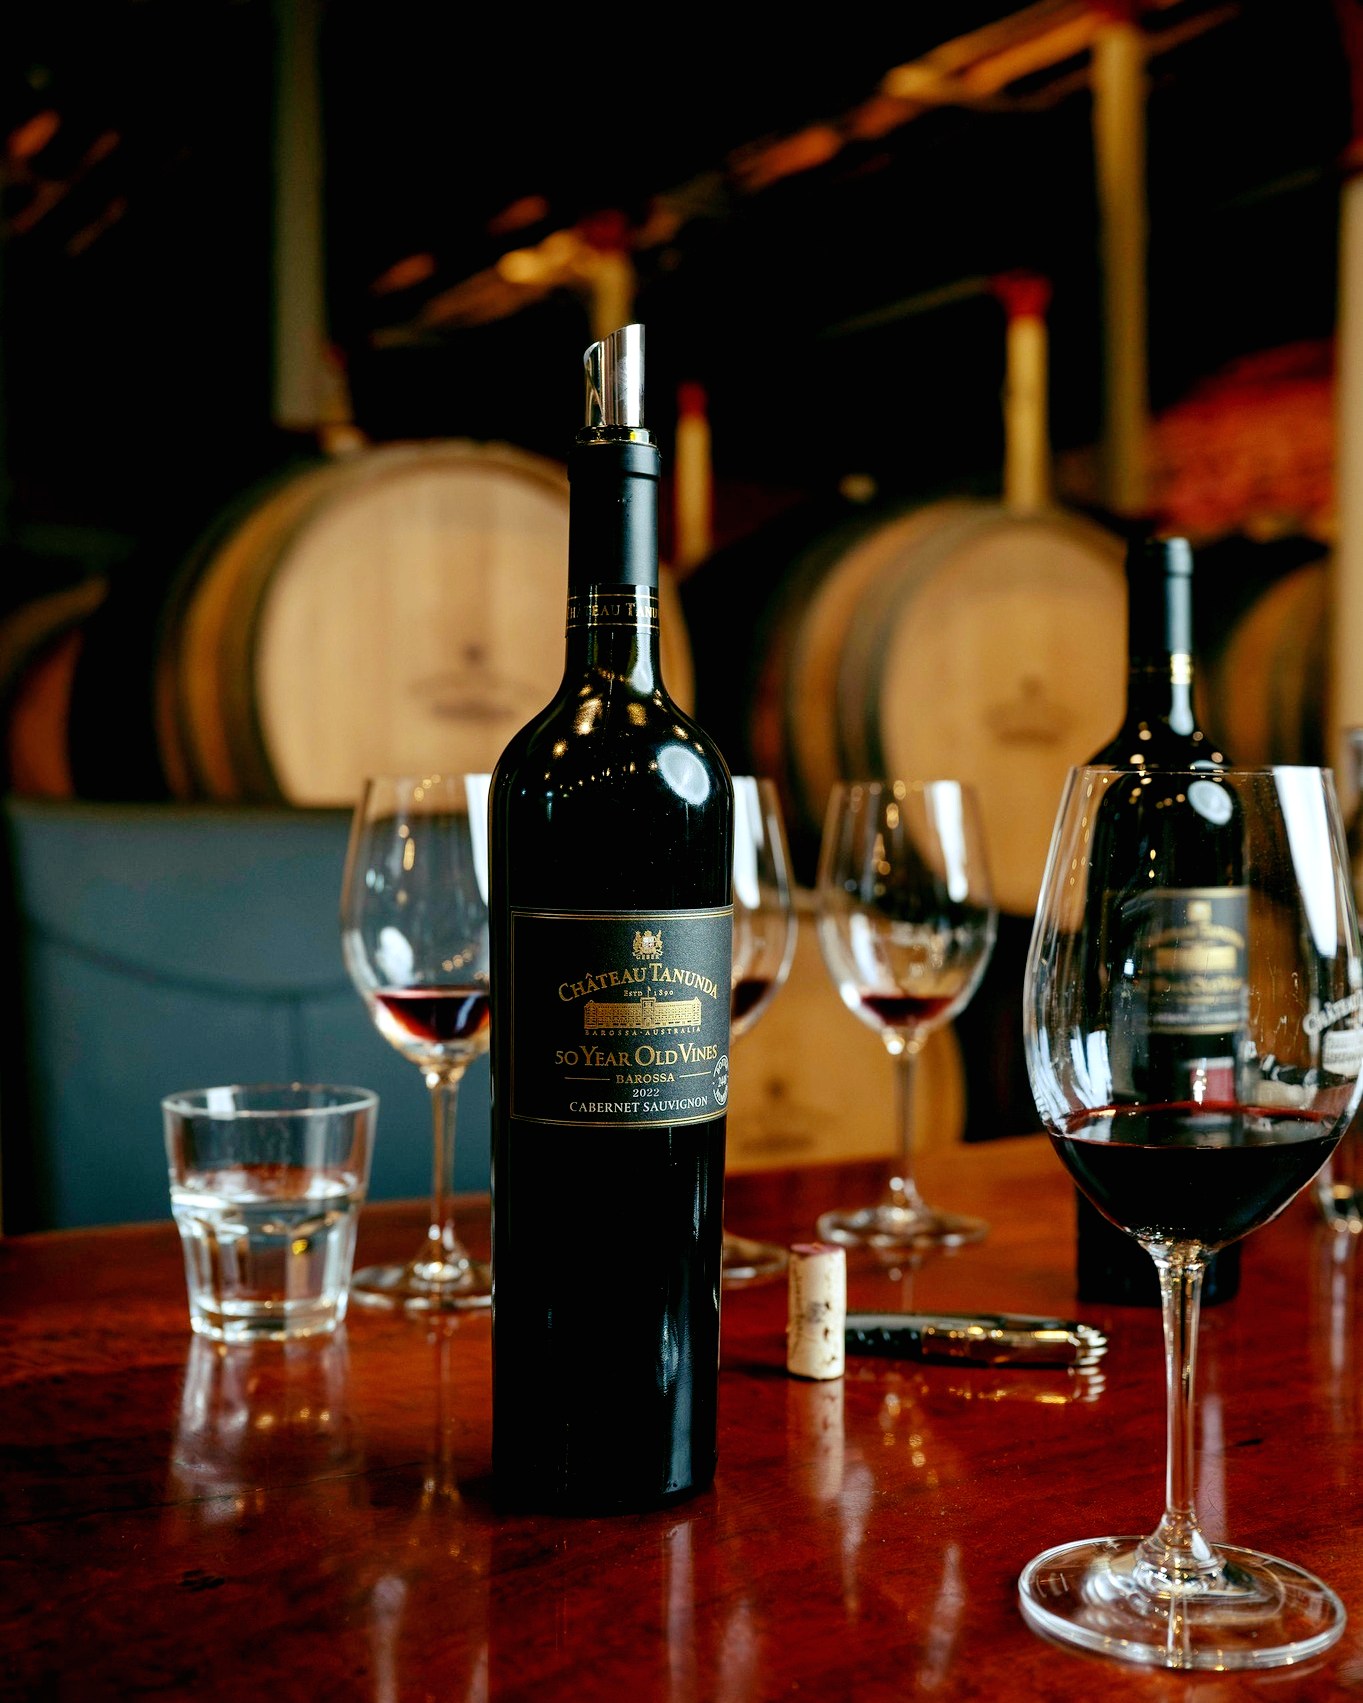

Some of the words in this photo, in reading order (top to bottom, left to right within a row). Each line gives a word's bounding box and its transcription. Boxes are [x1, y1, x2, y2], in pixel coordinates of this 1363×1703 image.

[558, 967, 647, 1002] CHÂTEAU
[649, 962, 718, 1000] TANUNDA
[654, 989, 674, 997] 1890
[554, 1050, 579, 1066] 50
[579, 1045, 633, 1067] YEAR
[634, 1045, 679, 1067] OLD
[678, 1042, 718, 1064] VINES
[615, 1072, 676, 1085] BAROSSA
[632, 1088, 660, 1098] 2022
[569, 1101, 640, 1113] CABERNET
[642, 1095, 709, 1112] SAUVIGNON
